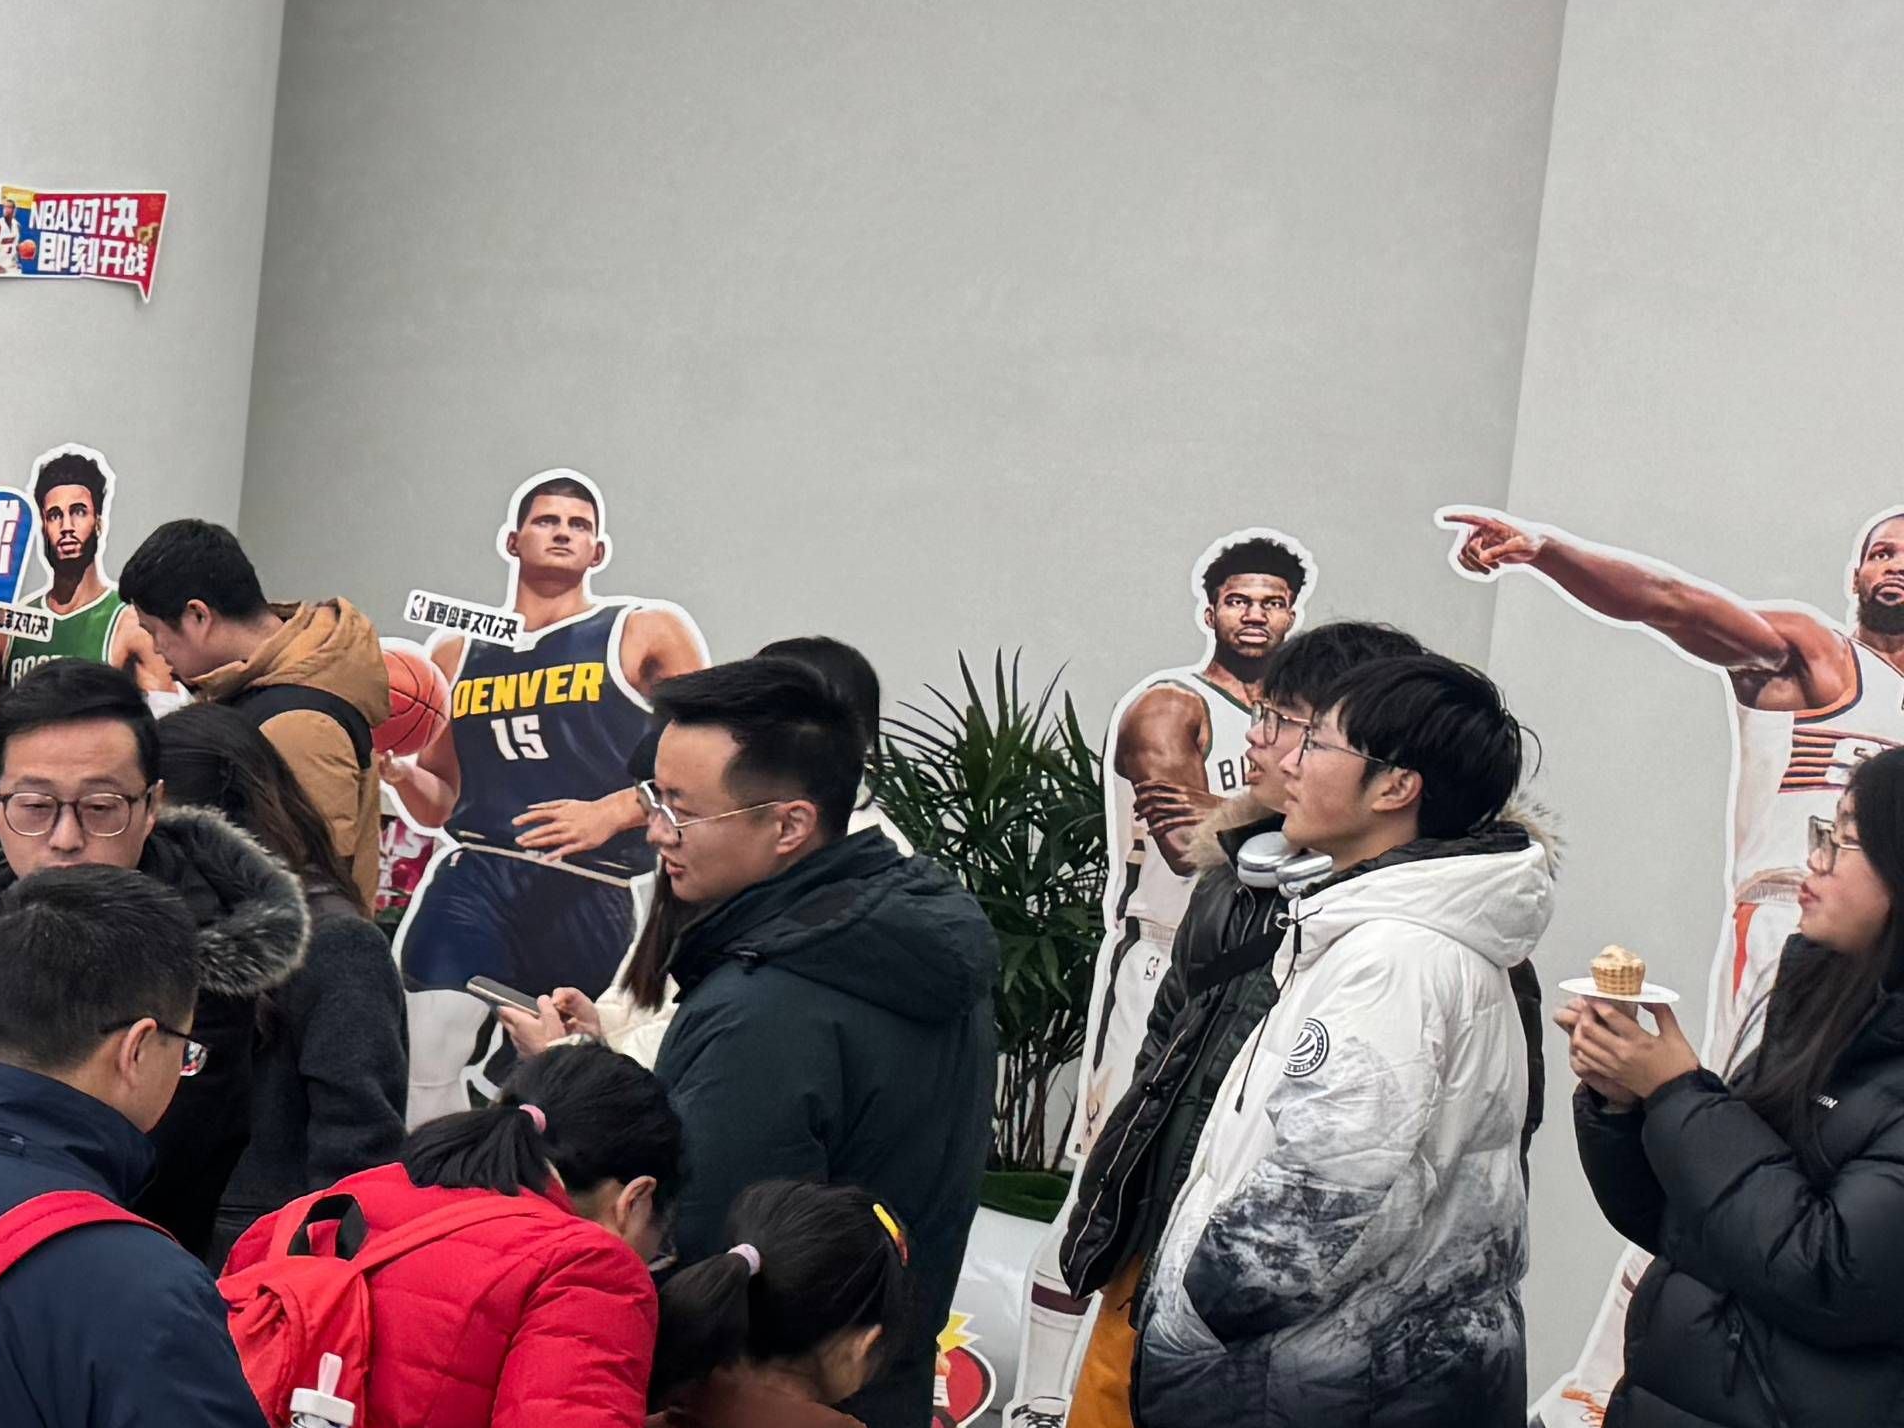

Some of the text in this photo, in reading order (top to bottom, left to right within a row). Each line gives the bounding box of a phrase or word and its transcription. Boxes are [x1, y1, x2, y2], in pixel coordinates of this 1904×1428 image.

[29, 197, 139, 237] NBA对决
[37, 231, 149, 277] 即刻开战
[452, 662, 605, 719] DENVER
[490, 714, 550, 761] 15
